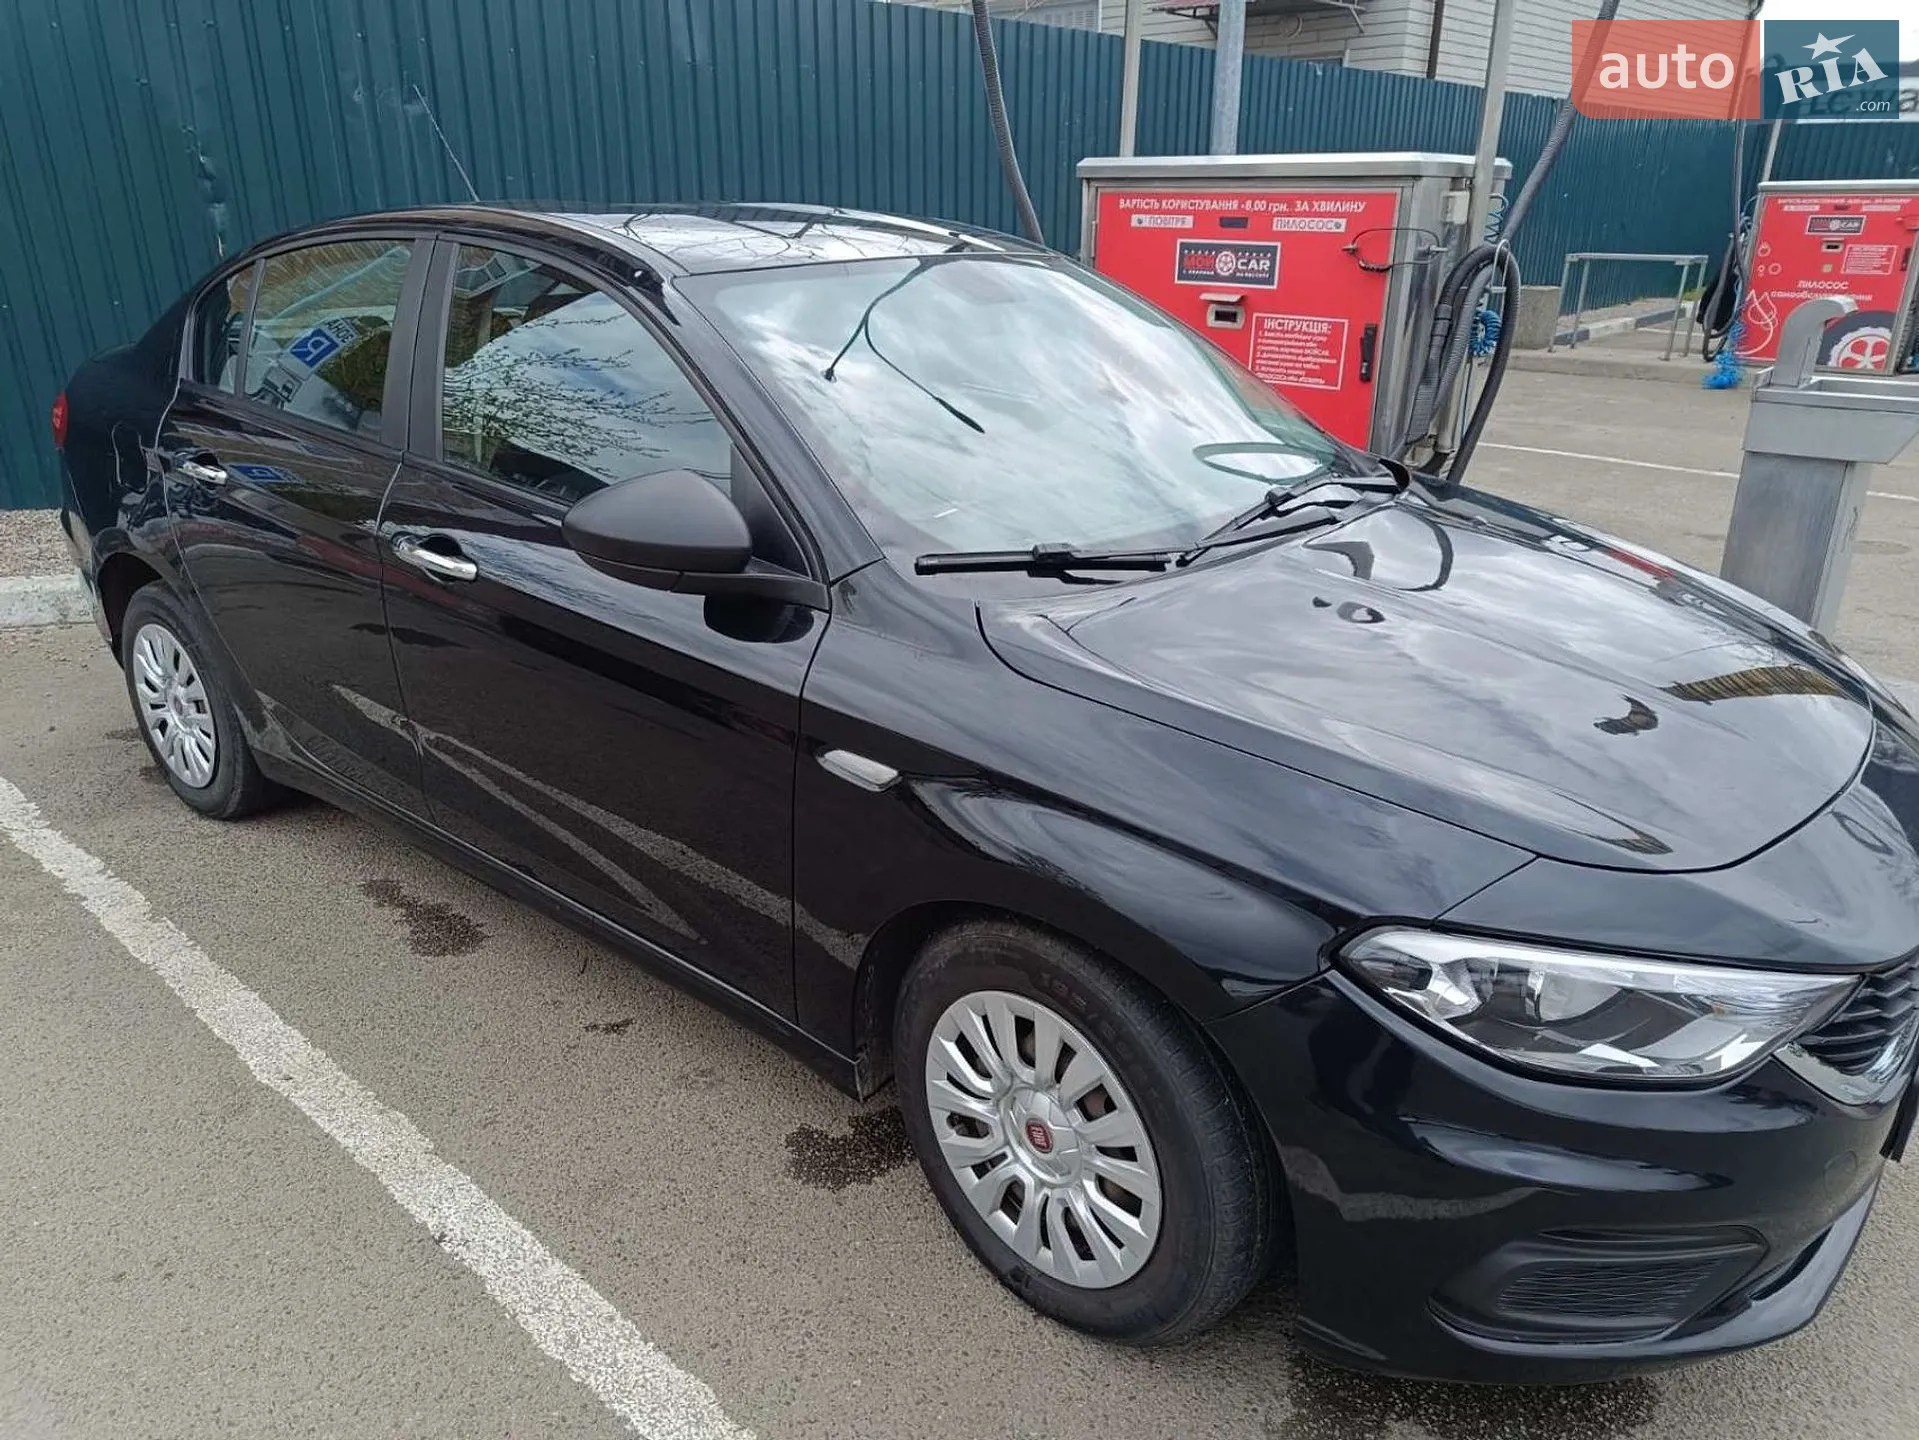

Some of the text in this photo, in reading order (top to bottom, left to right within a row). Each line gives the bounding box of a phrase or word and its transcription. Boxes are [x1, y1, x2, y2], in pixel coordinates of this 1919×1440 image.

[1119, 198, 1160, 209] ВАРТІСТЬ
[1161, 199, 1238, 211] КОРИСТУВАННЯ
[1294, 201, 1309, 212] ЗА
[1312, 201, 1366, 213] ХВИЛИНУ
[1275, 218, 1334, 231] ПИЛОСОС
[1237, 258, 1271, 271] CAR
[1264, 318, 1332, 334] ІНСТРУКЦІЯ:
